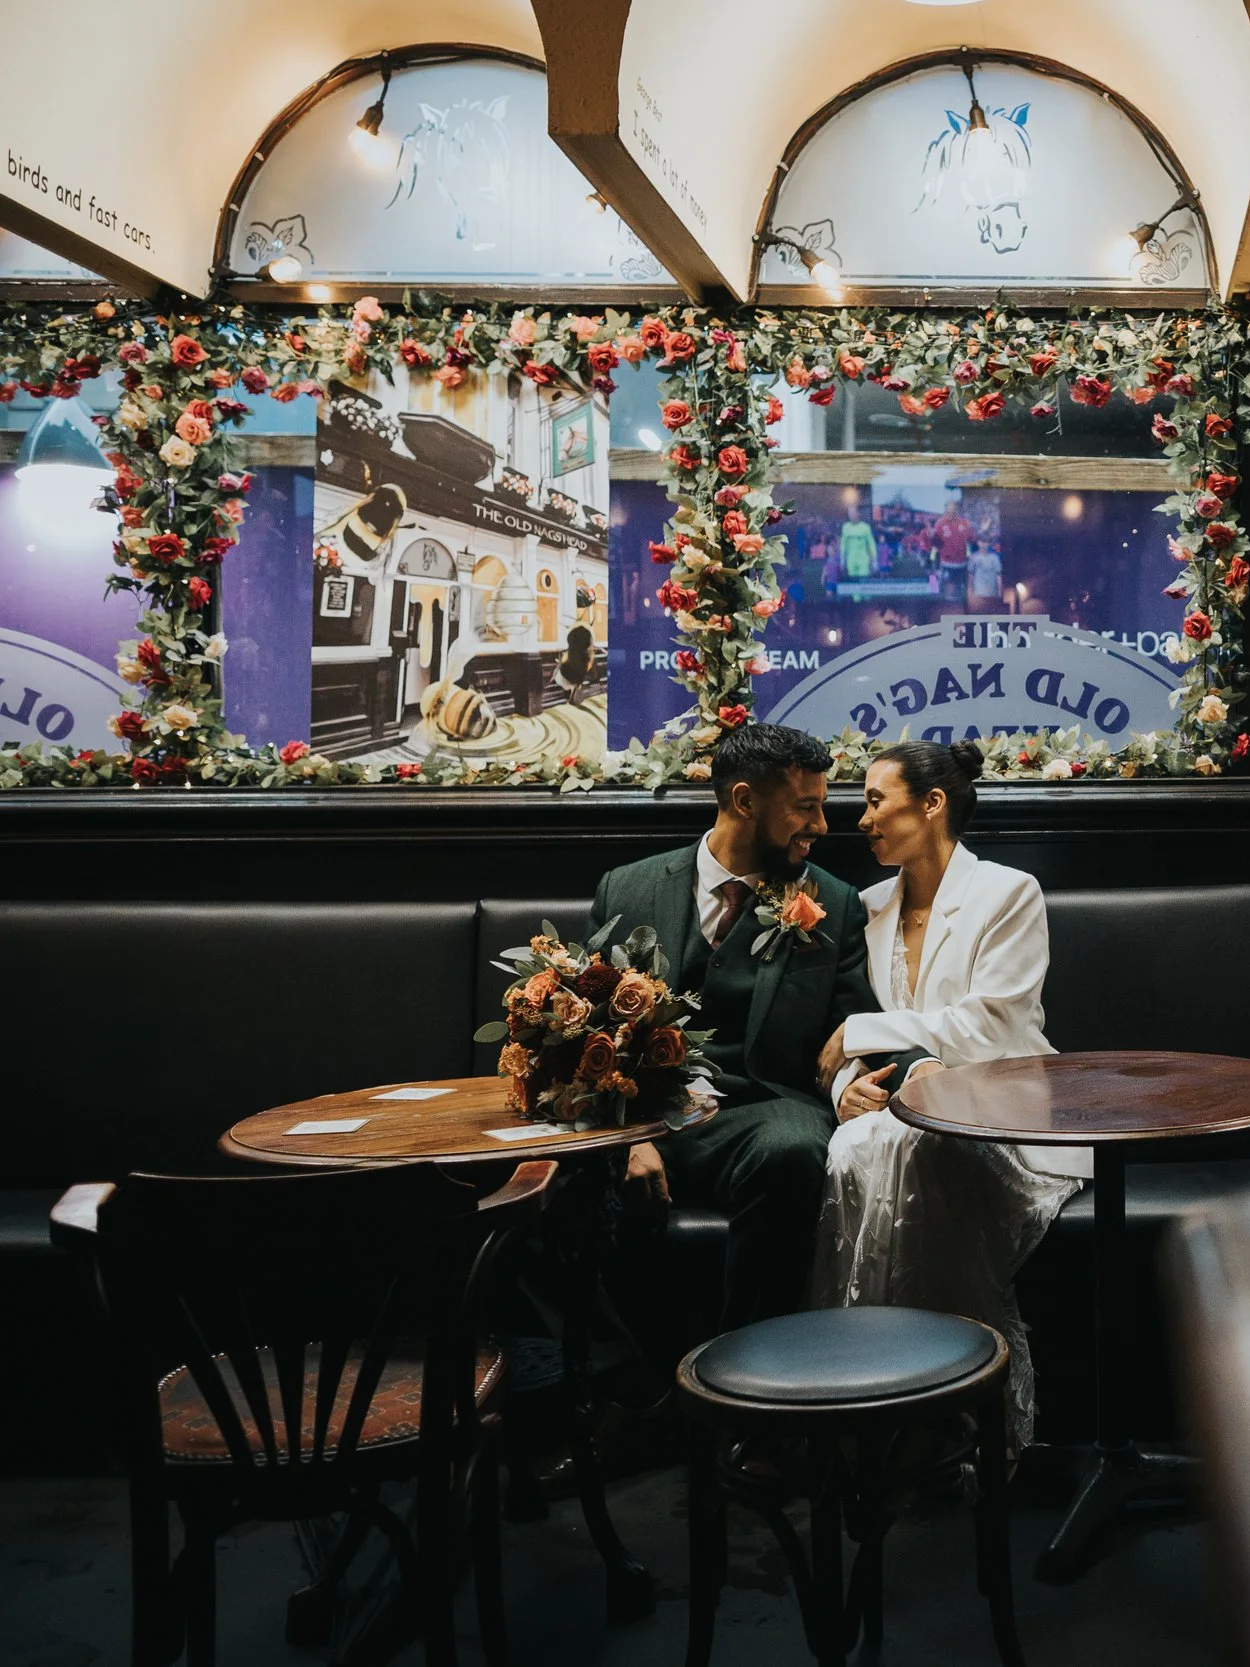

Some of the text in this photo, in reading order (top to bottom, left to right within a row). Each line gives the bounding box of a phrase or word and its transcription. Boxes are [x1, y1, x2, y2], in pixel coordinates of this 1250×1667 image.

[8, 148, 156, 254] birds and fast cars.
[633, 109, 708, 236] I spent a lot of money
[473, 503, 503, 525] THE
[504, 515, 532, 532] OLD
[763, 650, 820, 670] EAM
